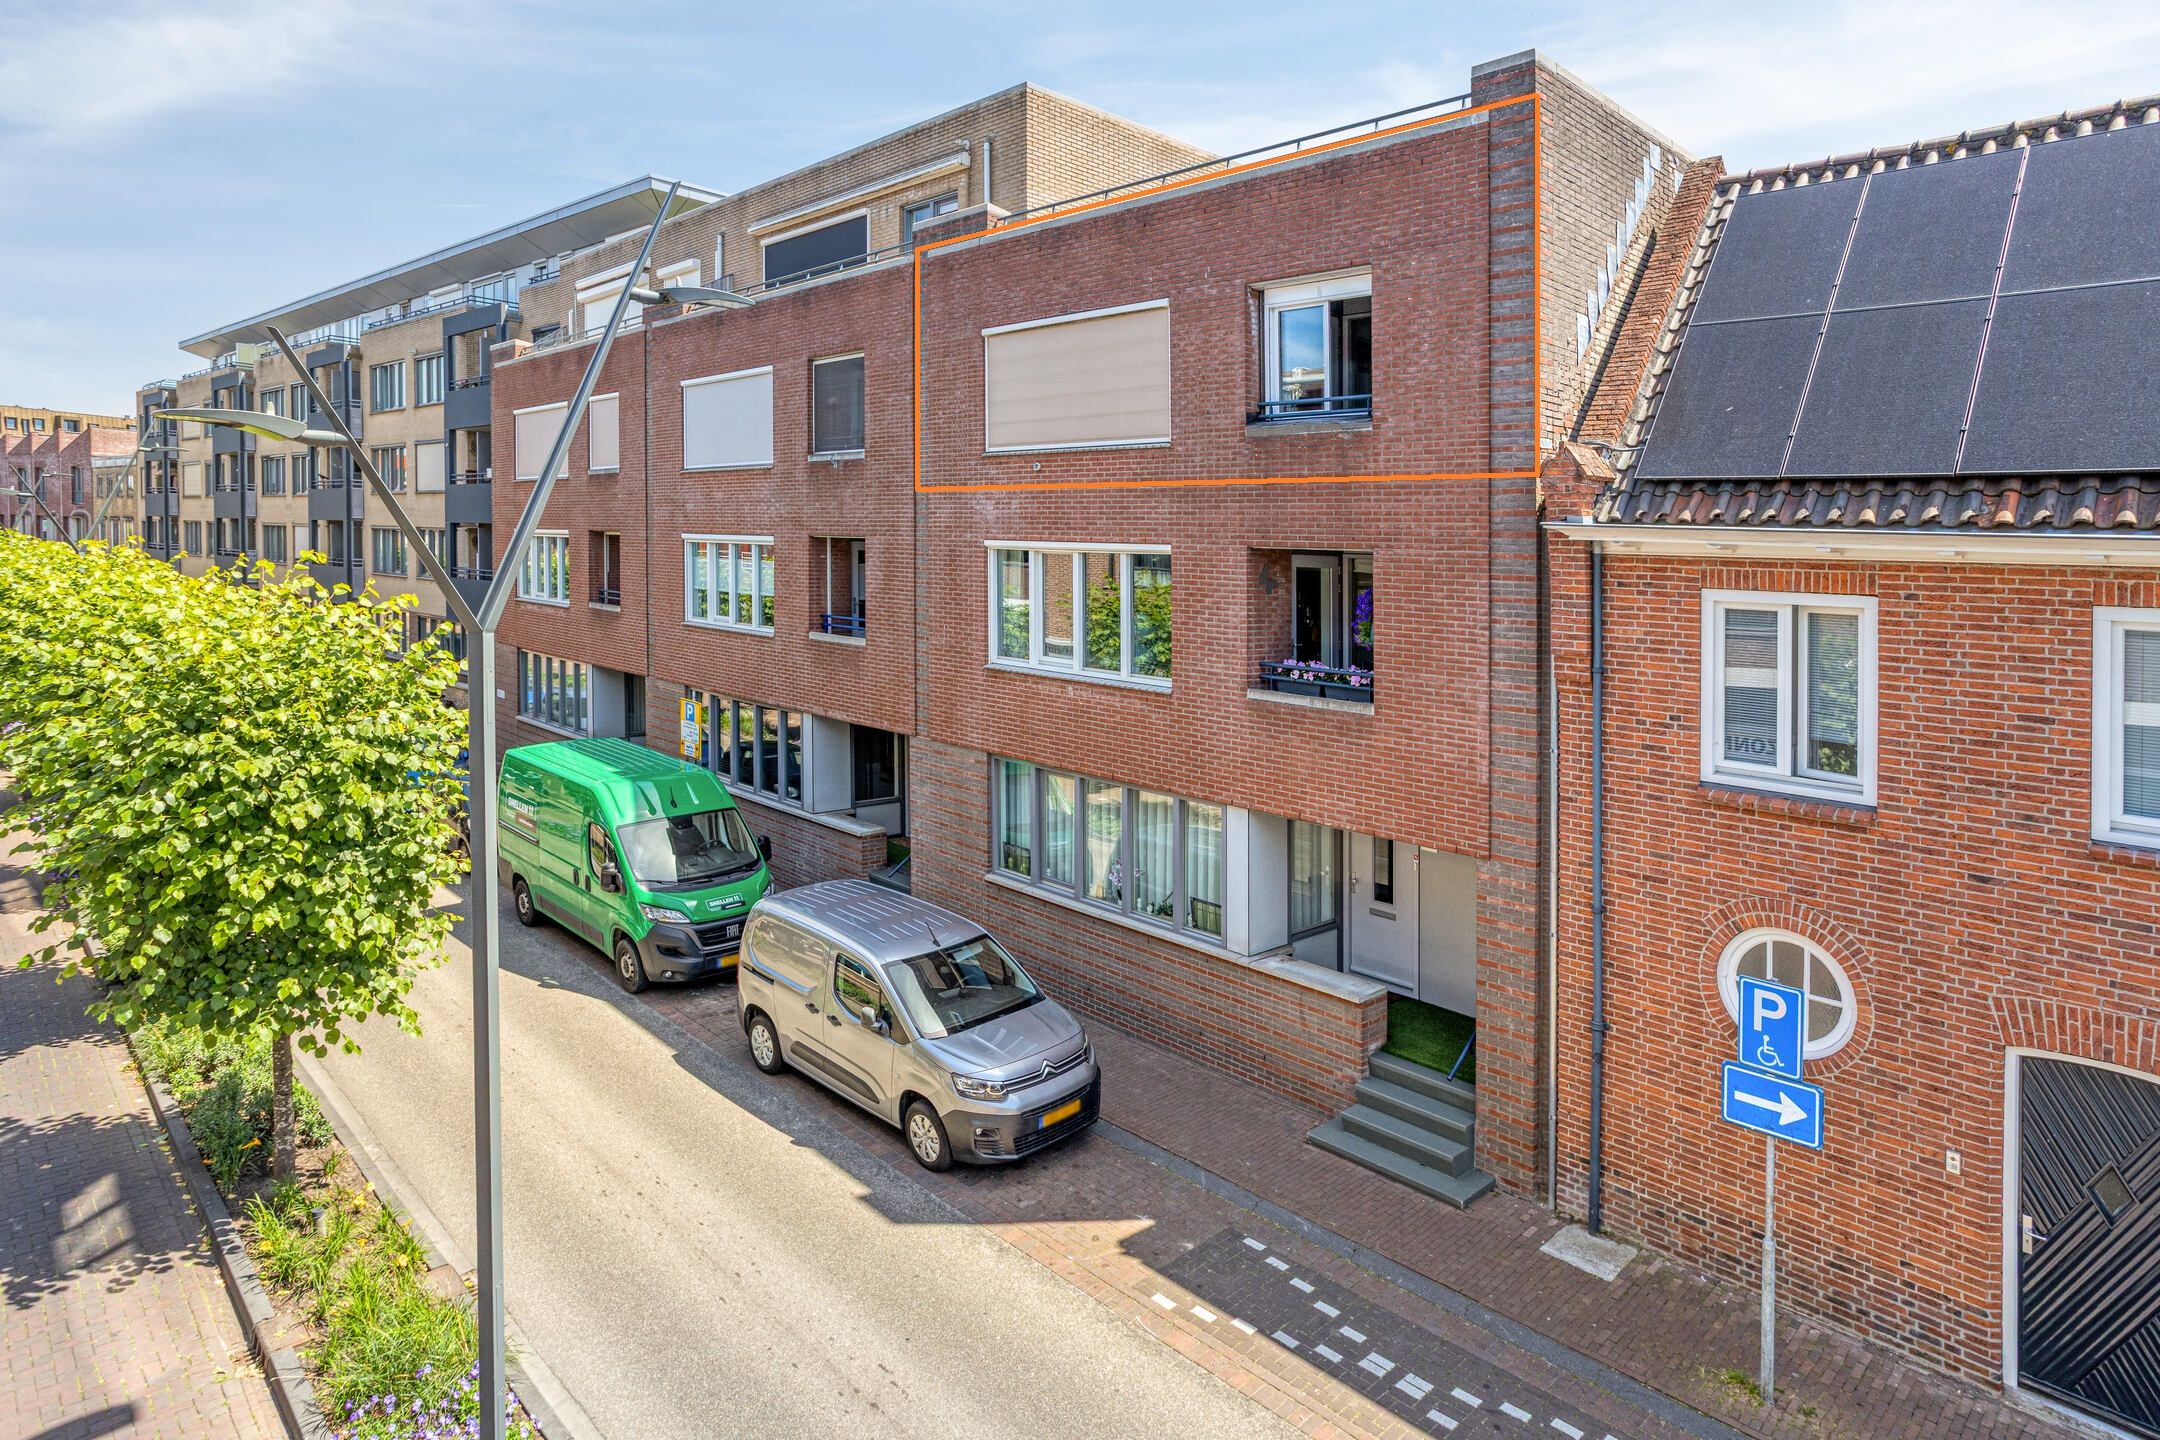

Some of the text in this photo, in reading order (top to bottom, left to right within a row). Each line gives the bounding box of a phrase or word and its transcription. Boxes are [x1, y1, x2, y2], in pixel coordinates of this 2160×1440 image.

[687, 704, 694, 720] P
[726, 924, 740, 938] FIAT
[1753, 988, 1787, 1032] P
